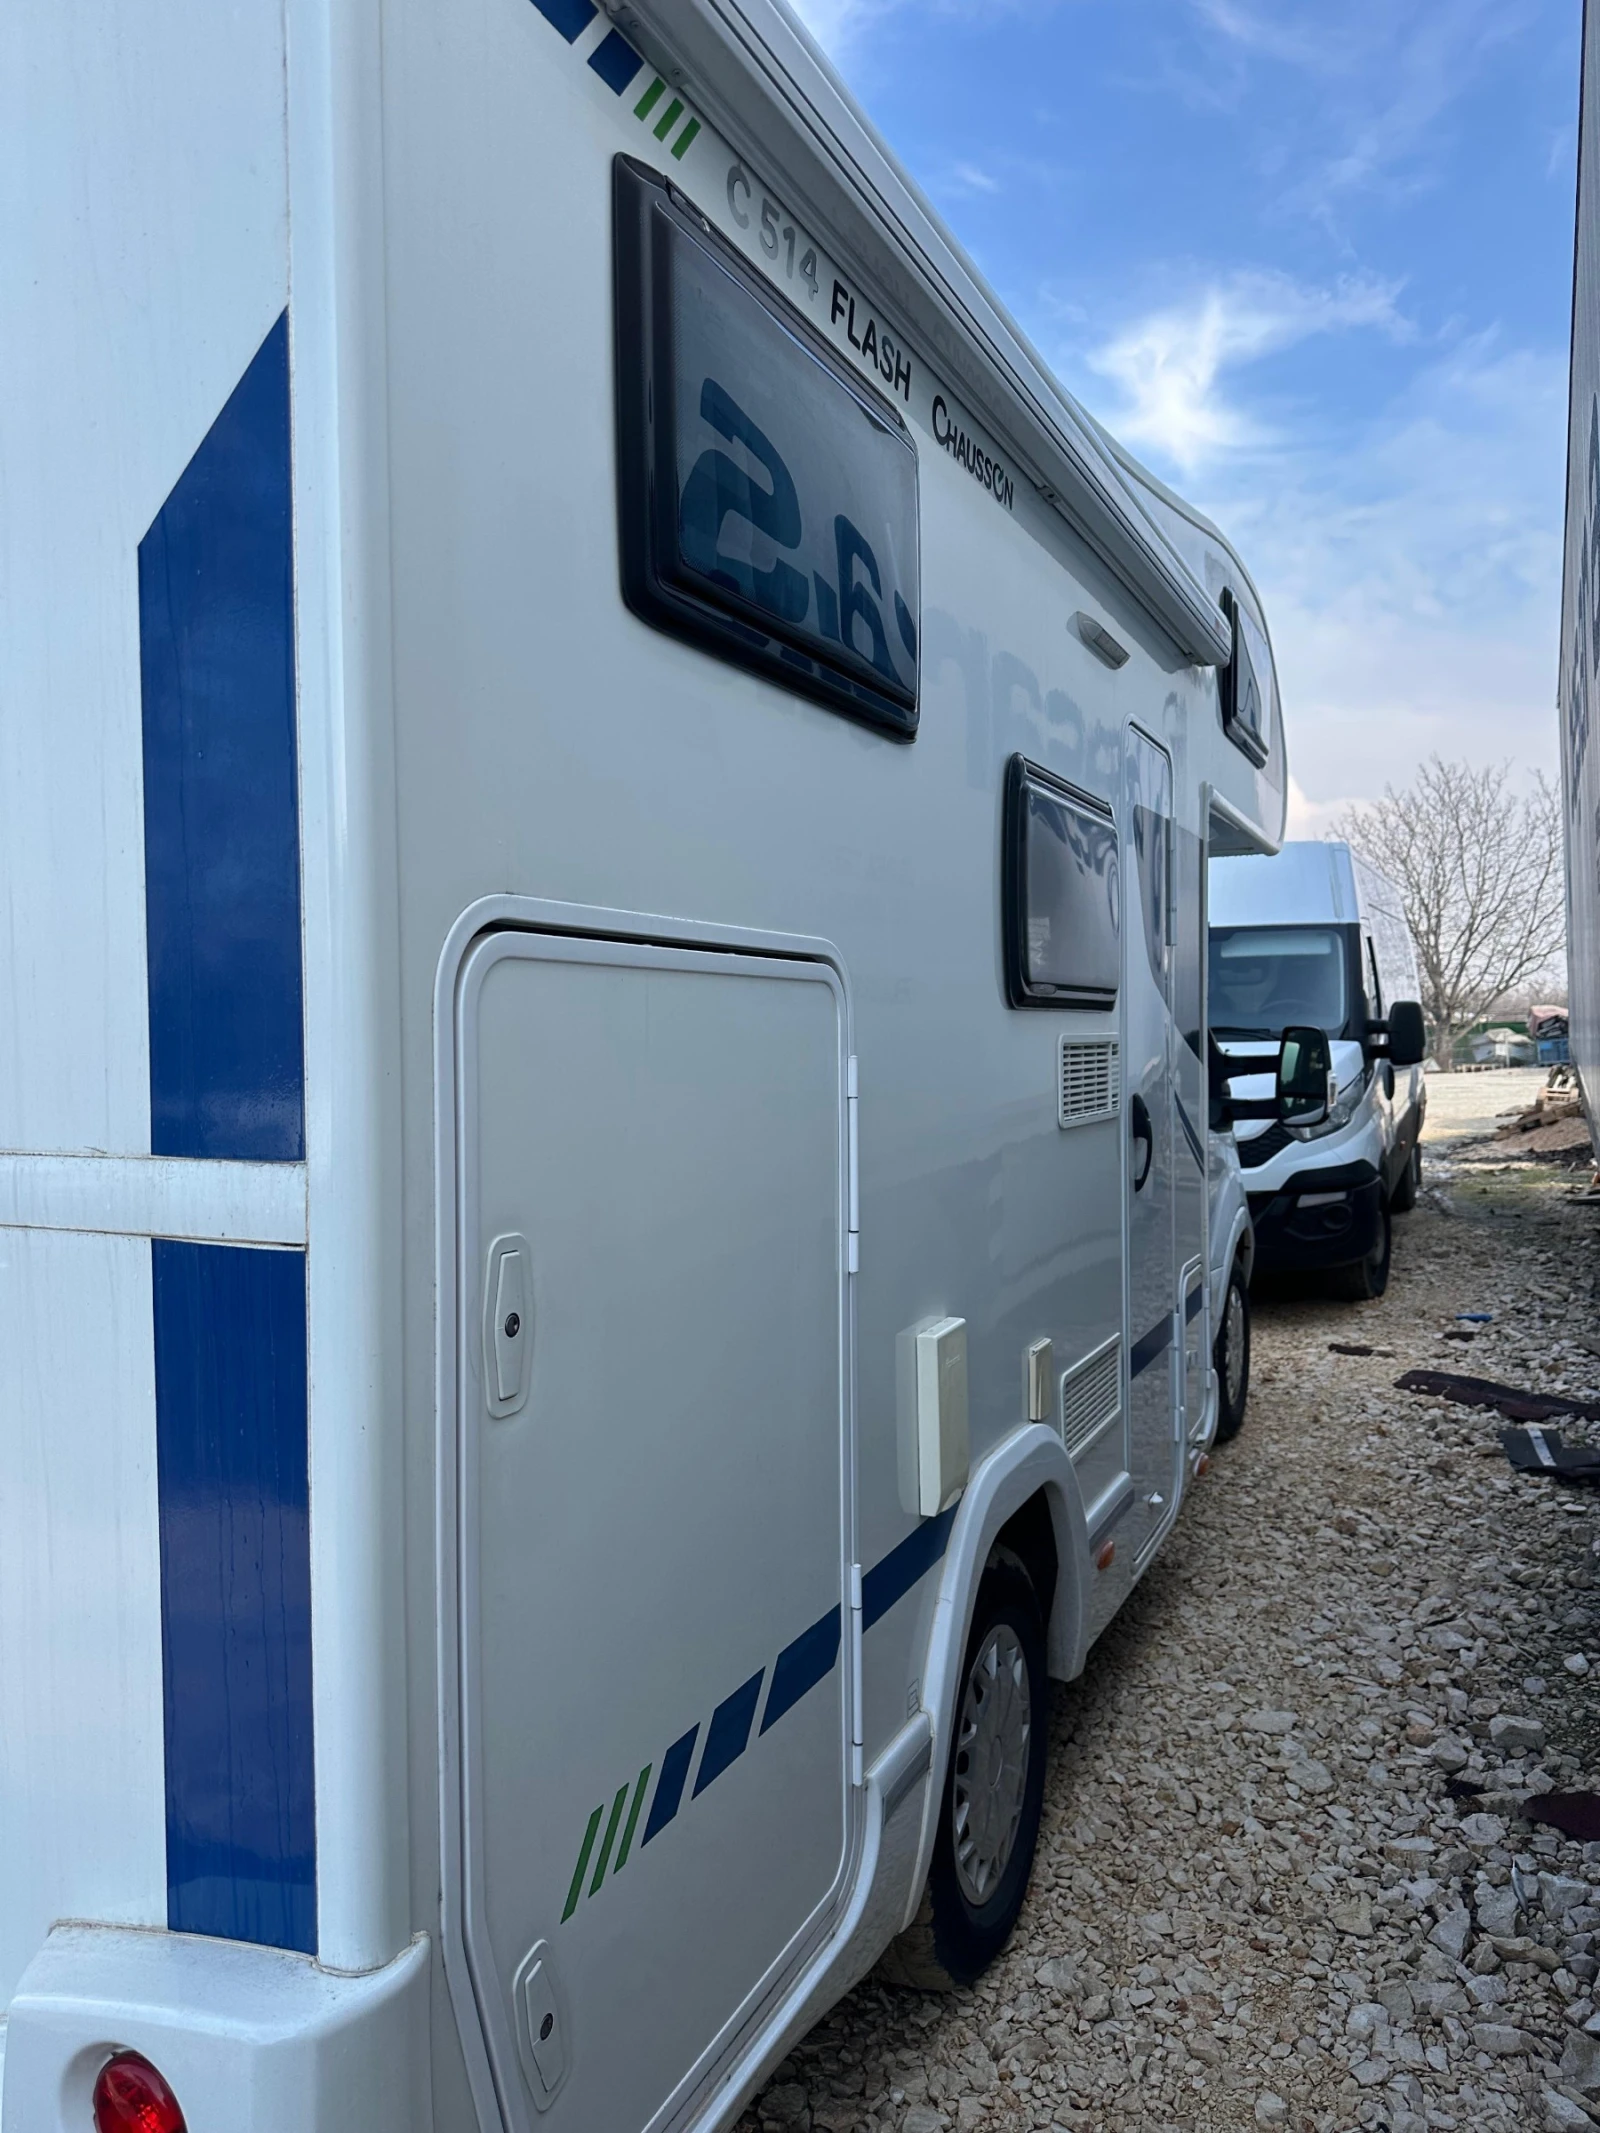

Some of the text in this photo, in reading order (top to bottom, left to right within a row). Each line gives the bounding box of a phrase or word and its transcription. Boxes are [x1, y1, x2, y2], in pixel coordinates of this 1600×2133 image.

[727, 165, 1014, 511] C 514 FLASH CHAUSSON
